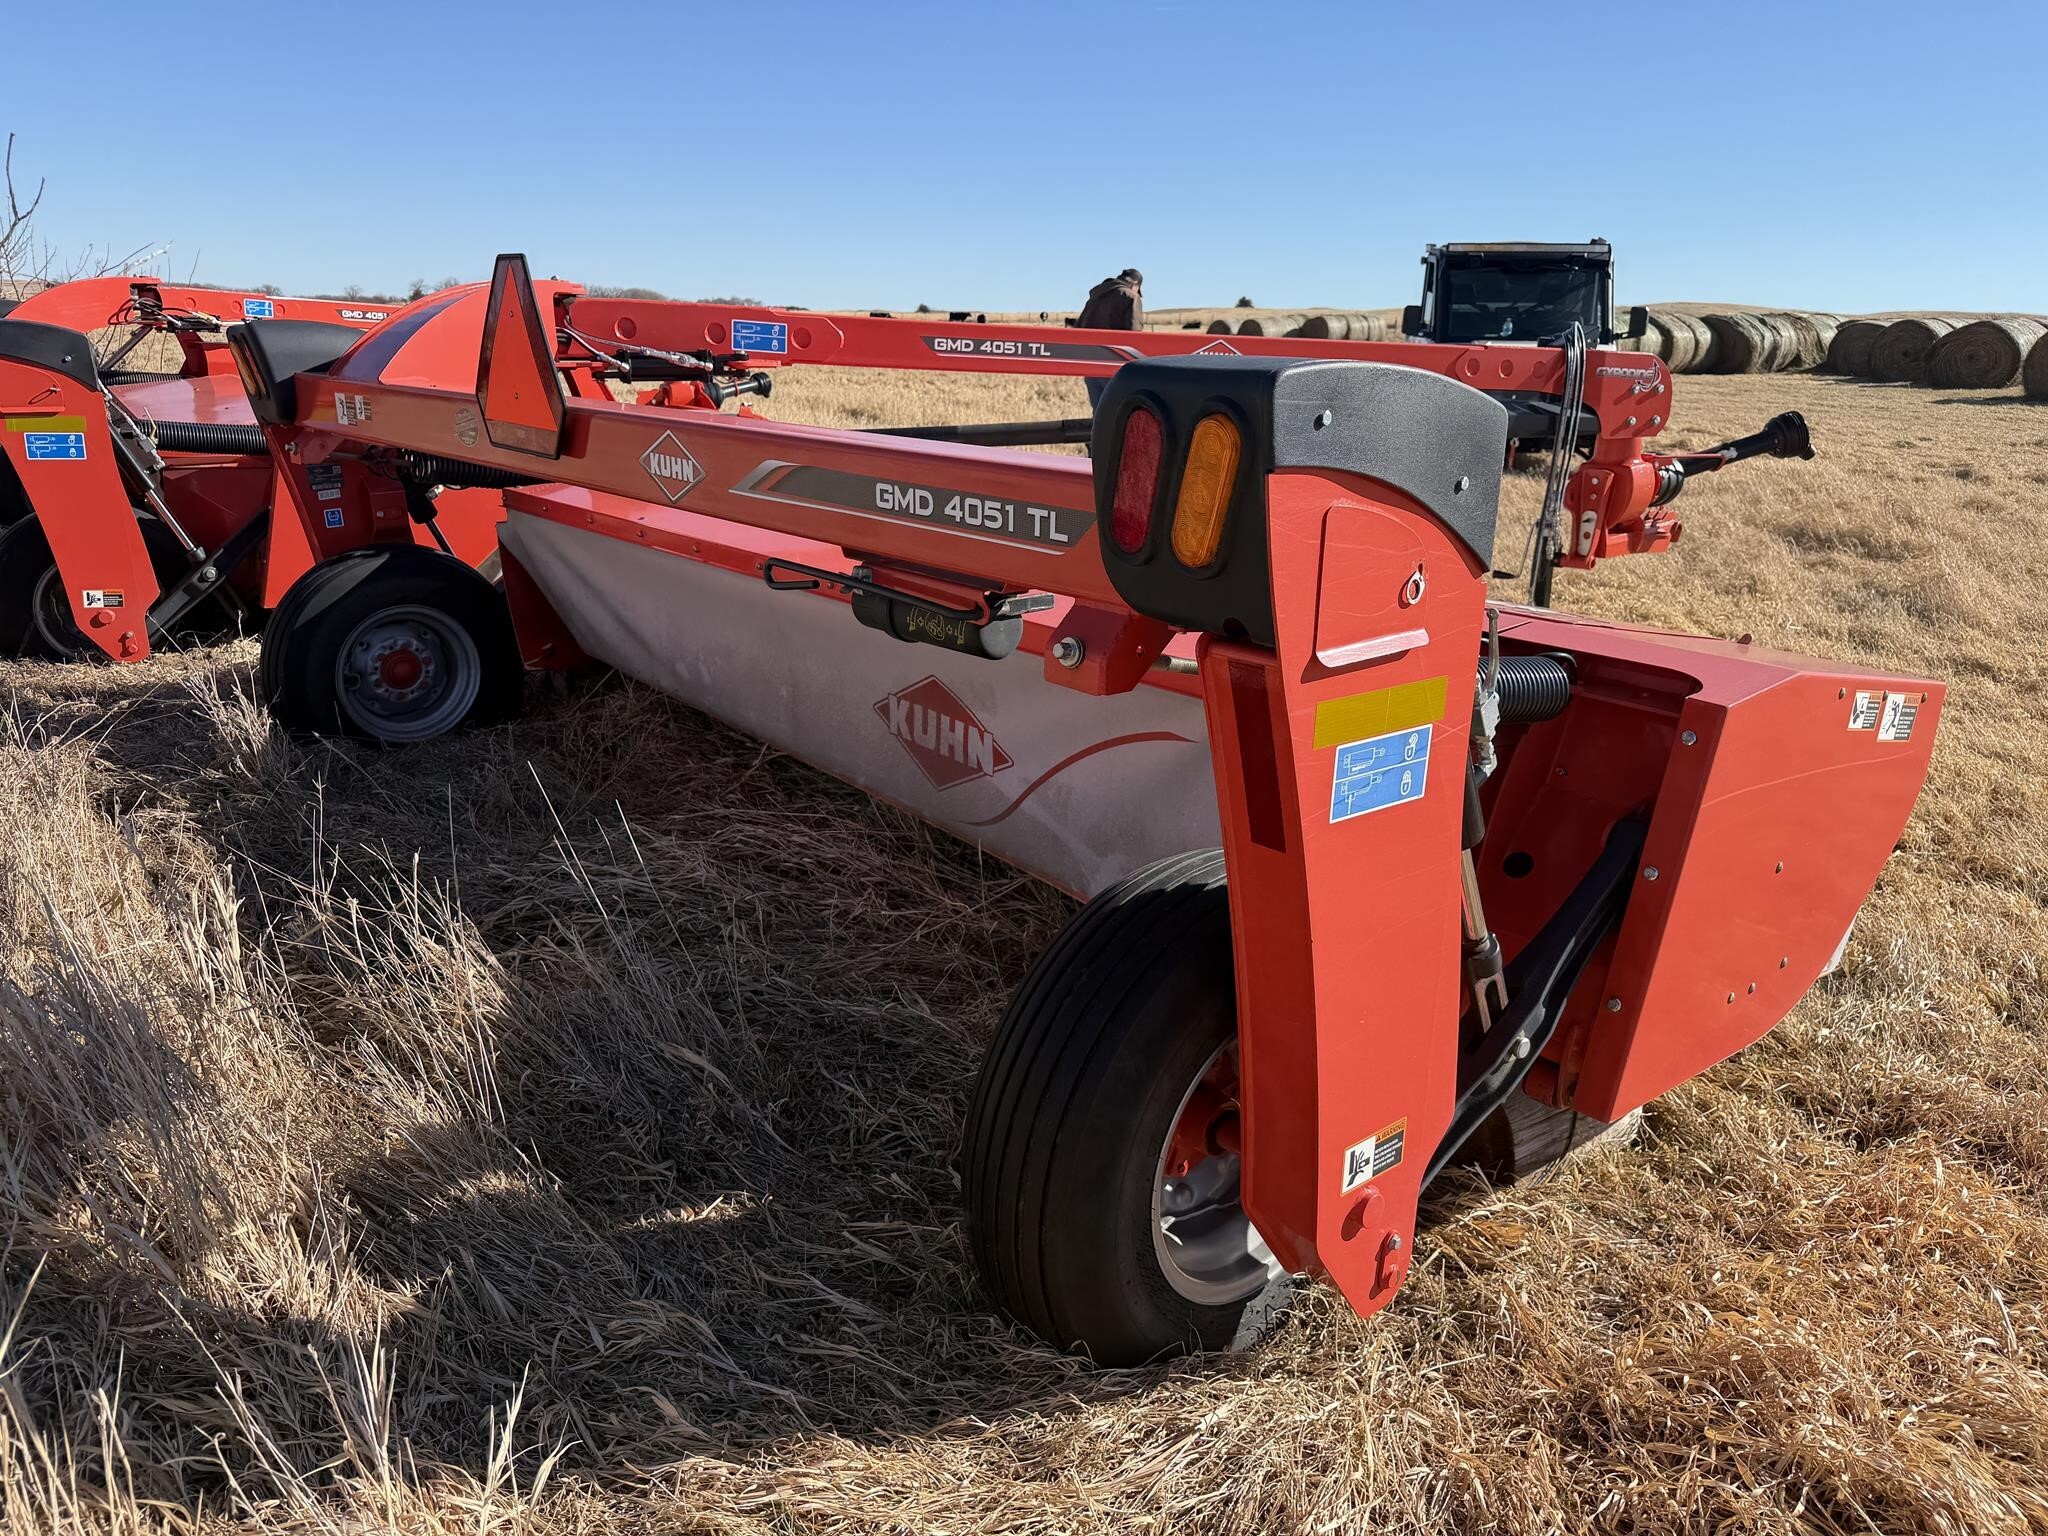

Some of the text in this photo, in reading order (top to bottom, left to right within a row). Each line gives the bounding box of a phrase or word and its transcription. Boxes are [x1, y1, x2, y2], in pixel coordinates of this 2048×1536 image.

[342, 310, 363, 318] GMD
[934, 338, 1051, 356] GMD 4051 TL
[649, 452, 694, 483] KUHN
[875, 482, 1069, 543] GMD 4051 TL
[888, 693, 994, 777] KUHN
